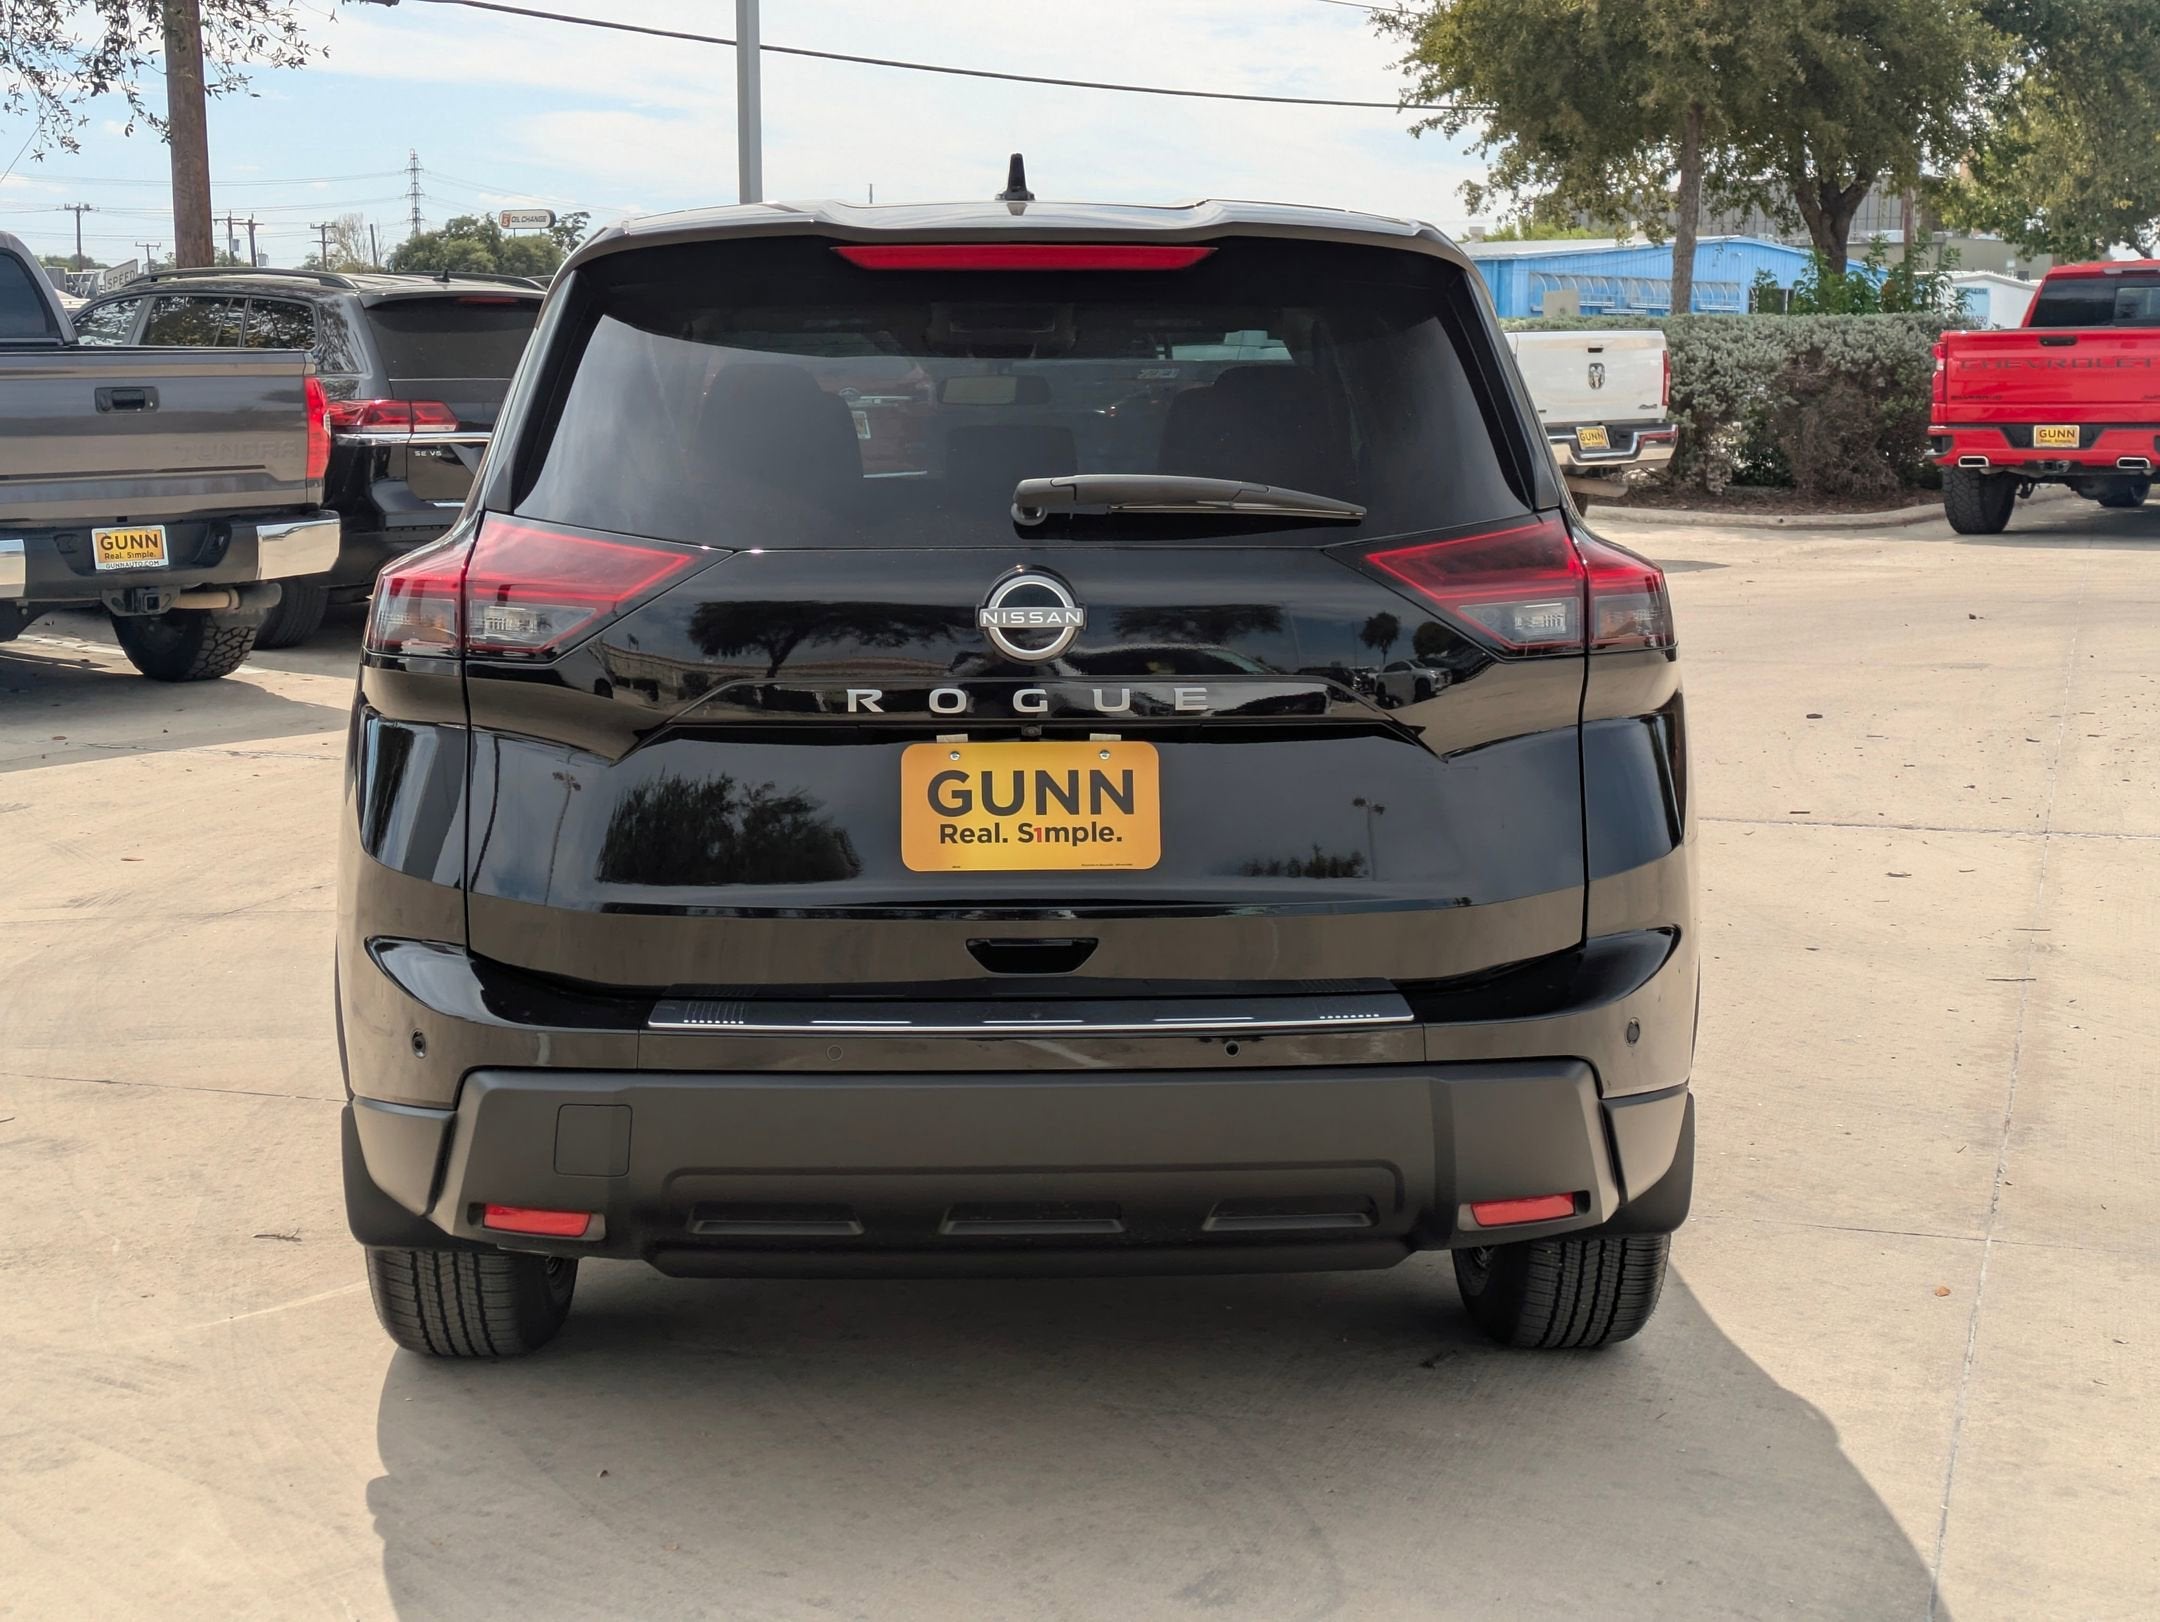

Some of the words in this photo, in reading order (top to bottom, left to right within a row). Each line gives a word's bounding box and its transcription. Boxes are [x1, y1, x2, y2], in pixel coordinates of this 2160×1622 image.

[521, 215, 547, 223] CHANGE
[107, 270, 136, 290] SPEED
[1960, 357, 2153, 369] CHEVROLET
[1580, 431, 1604, 442] GUNN
[2039, 429, 2075, 439] GUNN
[100, 534, 159, 551] GUNN
[981, 610, 1083, 625] NISSAN
[846, 687, 1210, 714] ROGUE
[927, 768, 1136, 818] GUNN
[939, 823, 1009, 845] Real.
